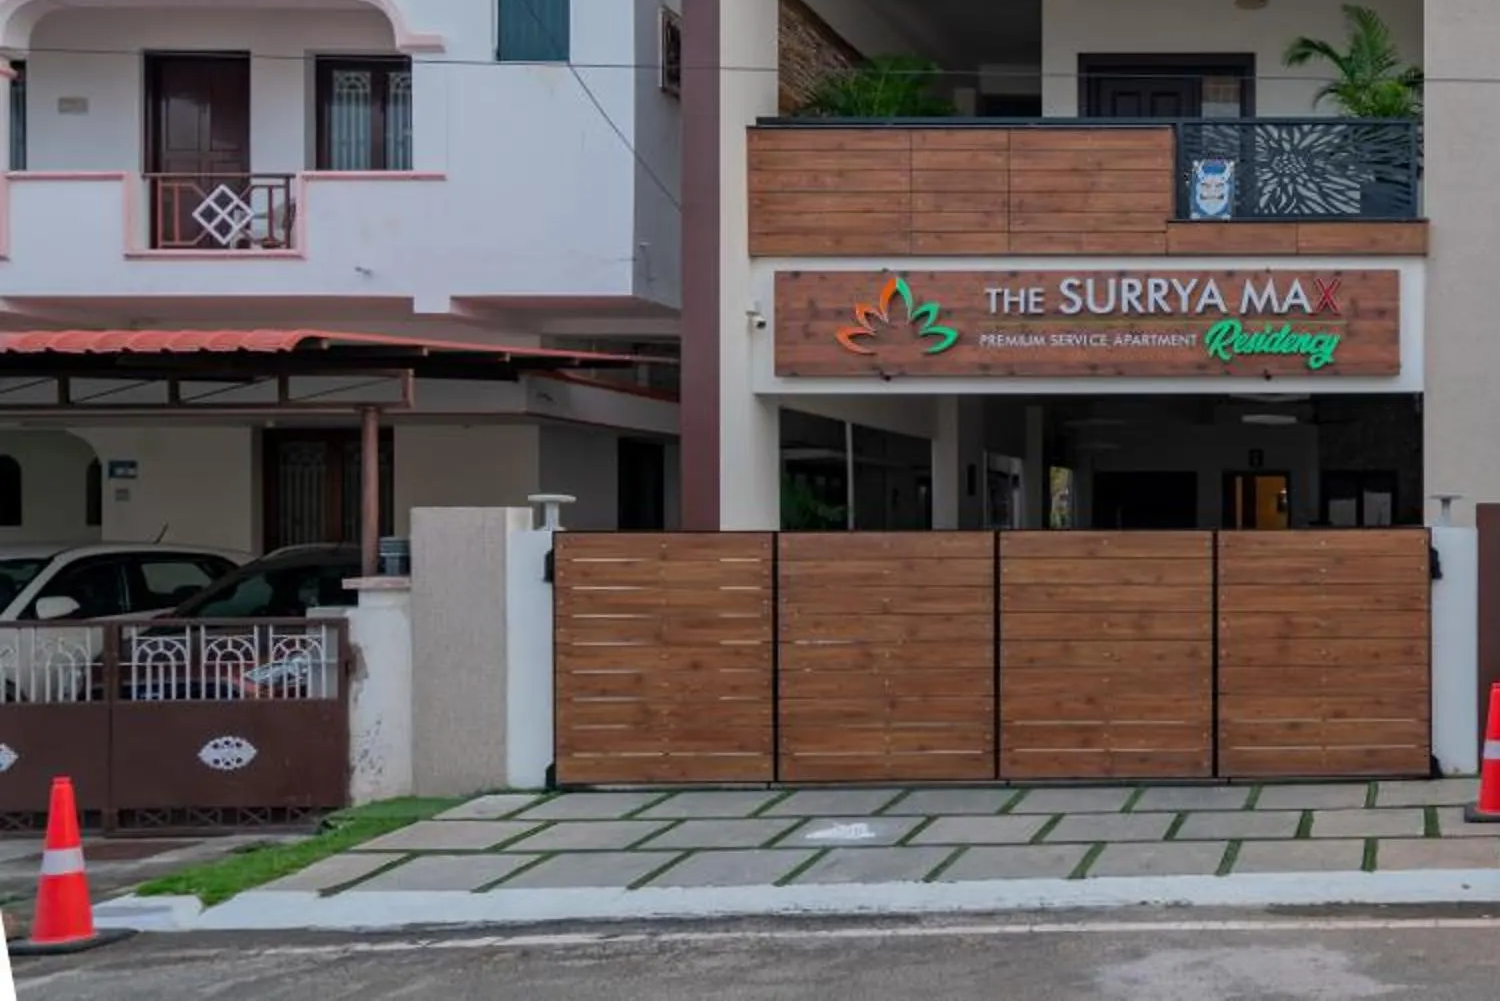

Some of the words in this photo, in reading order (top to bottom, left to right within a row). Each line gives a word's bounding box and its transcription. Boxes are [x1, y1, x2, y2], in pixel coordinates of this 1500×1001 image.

[984, 287, 1045, 314] THE
[1059, 278, 1228, 315] SURRYA
[1239, 278, 1342, 314] MAX
[979, 334, 1046, 347] PREMIUM
[1050, 334, 1110, 347] SERVICE
[1113, 334, 1197, 347] APARTMENT
[1204, 318, 1342, 369] Residency
